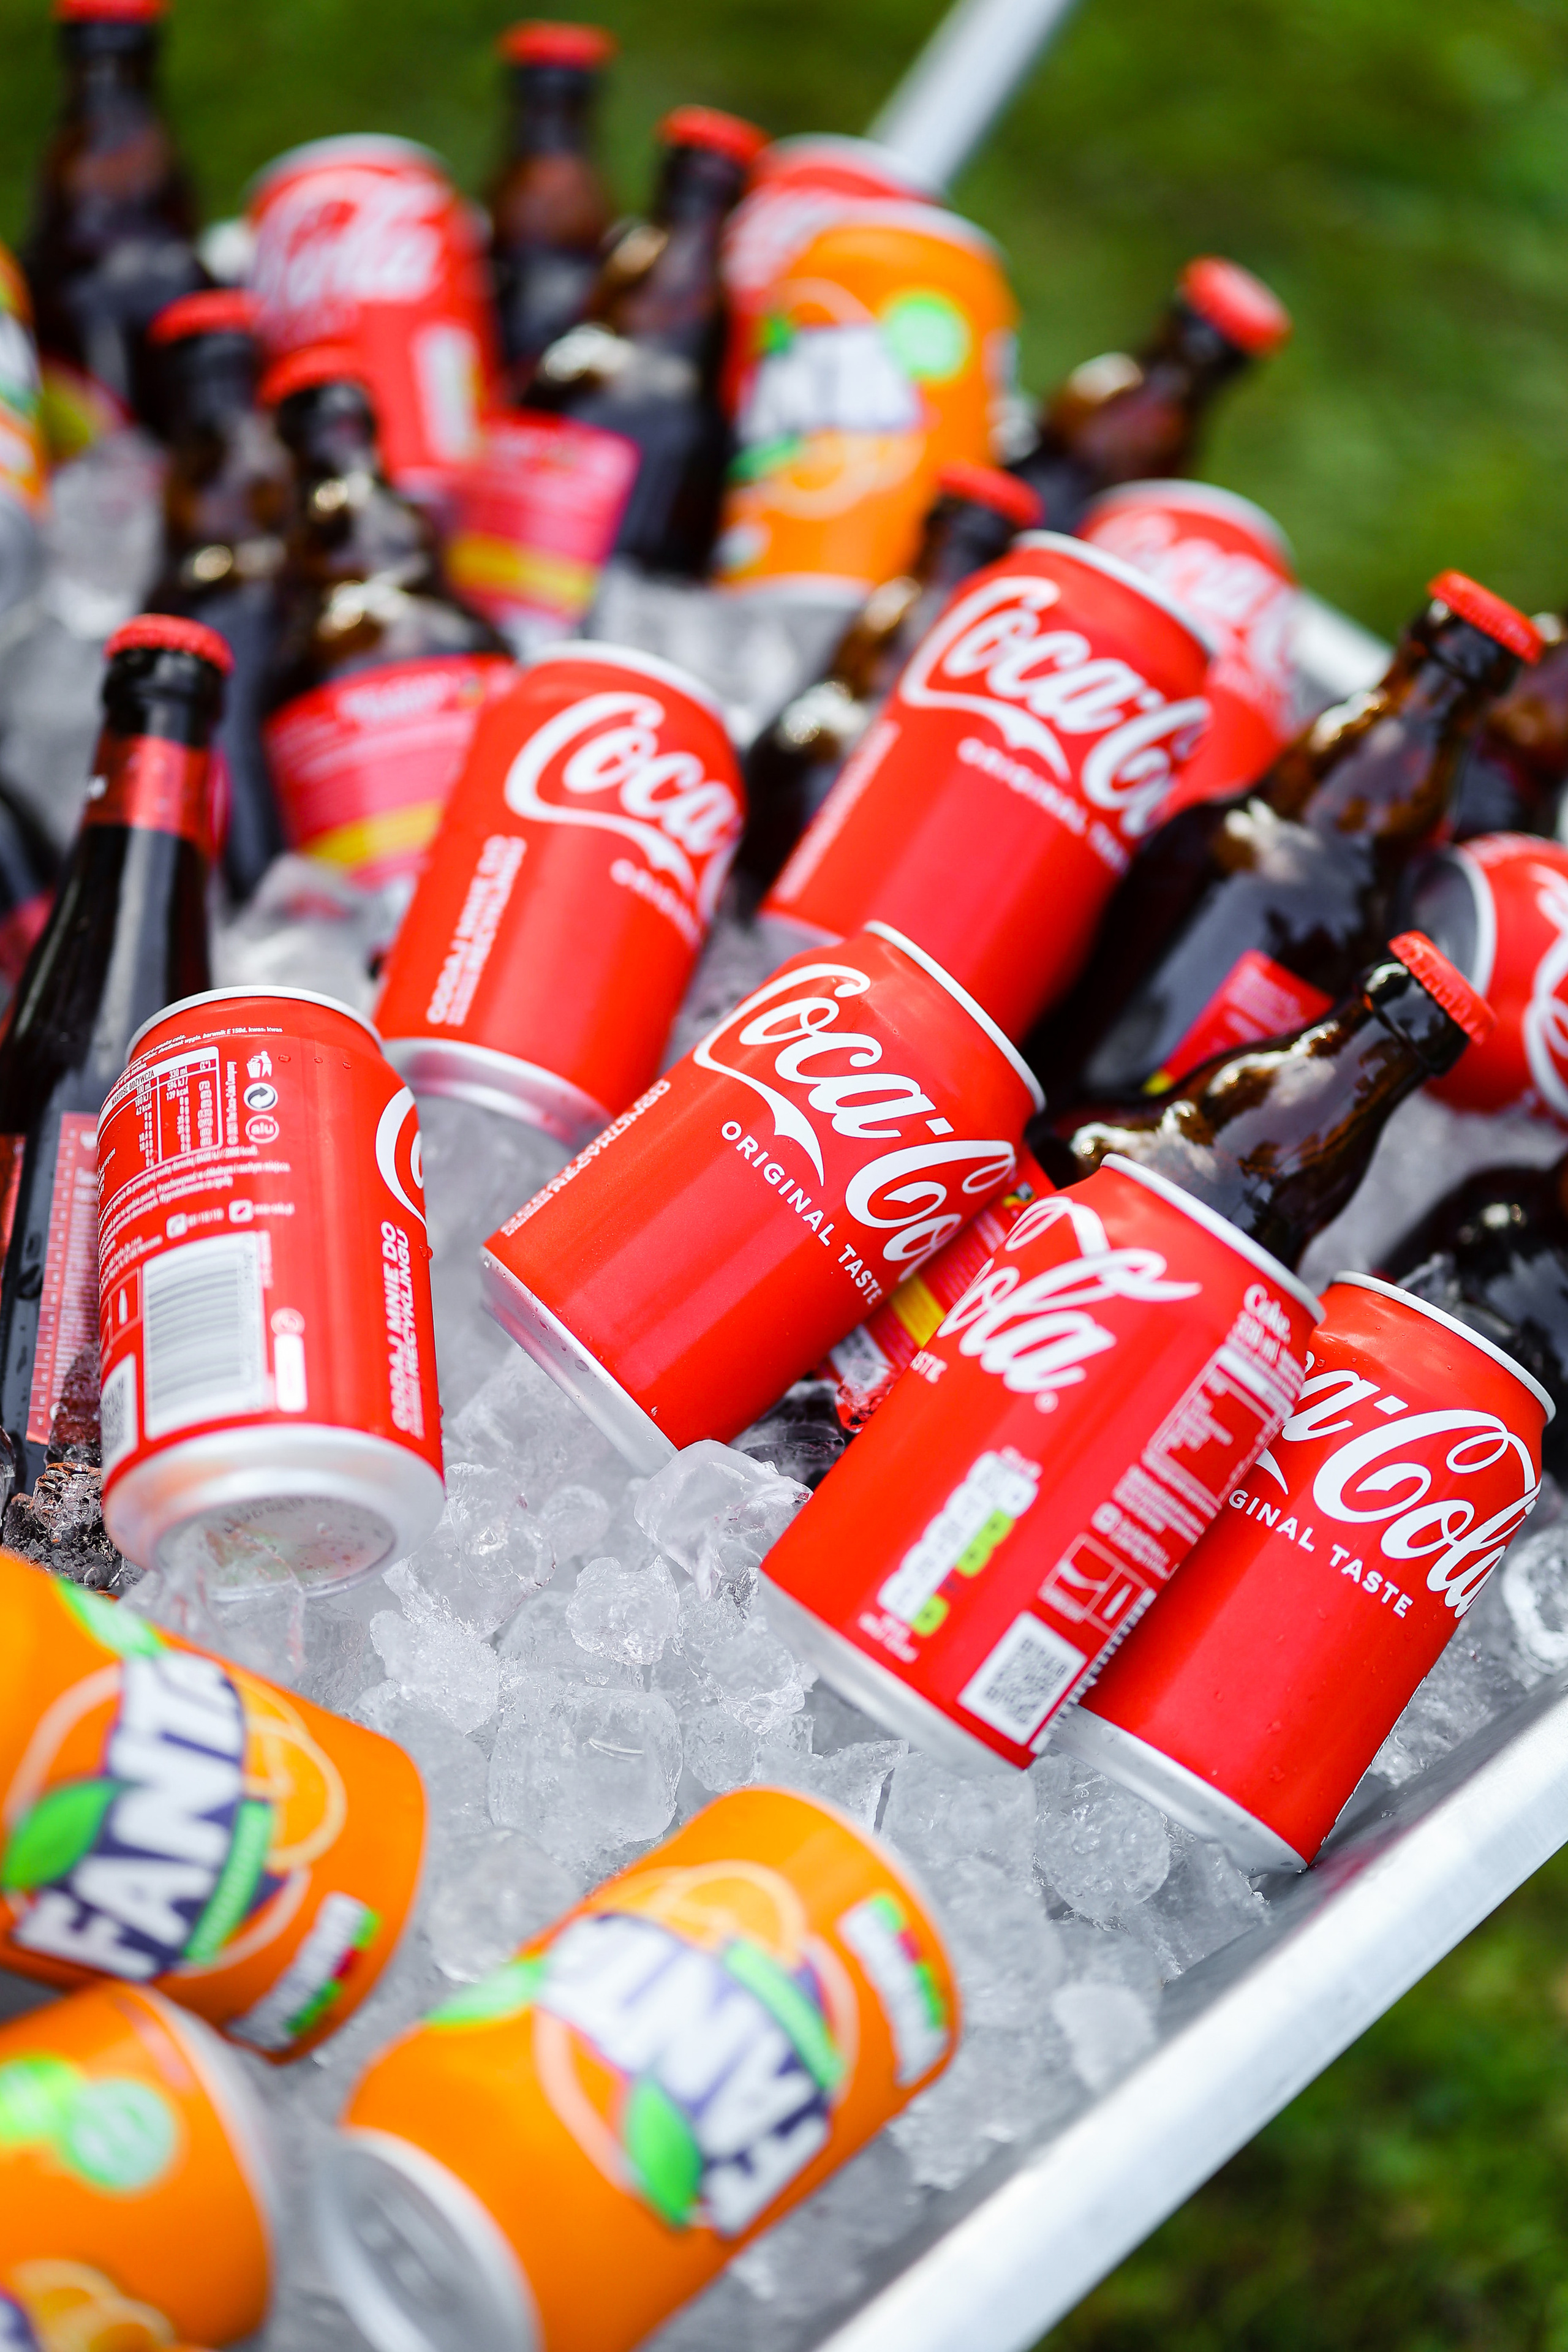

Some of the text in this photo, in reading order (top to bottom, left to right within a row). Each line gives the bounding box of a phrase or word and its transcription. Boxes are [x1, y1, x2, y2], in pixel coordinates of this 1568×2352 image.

[129, 1069, 154, 1090] ODŻYWCZA
[169, 1069, 179, 1079] 330
[251, 1121, 274, 1135] alu
[693, 962, 1017, 1283] Coca-Co
[721, 1121, 883, 1305] ORIGINAL TASTE
[381, 1221, 398, 1262] DO
[383, 1263, 404, 1333] MNIE
[1228, 1488, 1315, 1553] GINAL
[1329, 1544, 1414, 1618] TASTE
